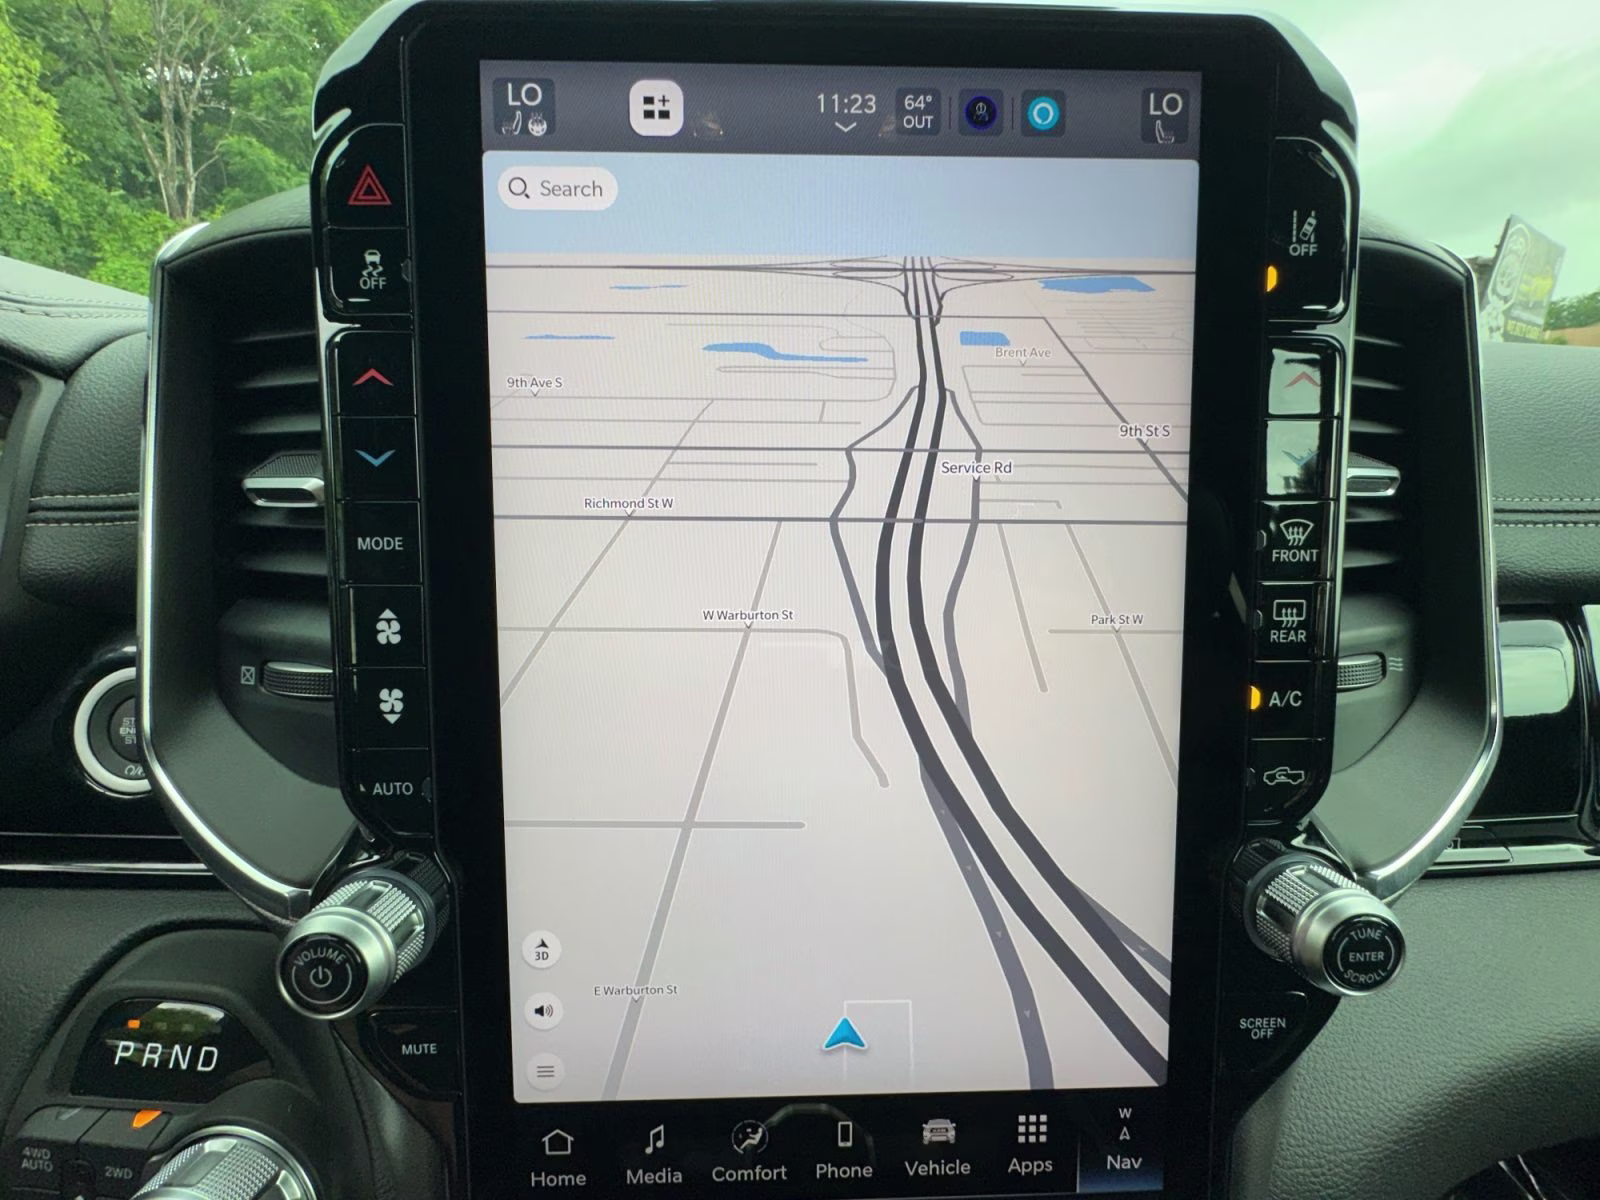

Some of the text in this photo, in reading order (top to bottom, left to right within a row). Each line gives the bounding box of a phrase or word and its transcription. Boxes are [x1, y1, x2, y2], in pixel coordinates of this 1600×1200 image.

[508, 83, 542, 107] LO
[817, 94, 877, 114] 11:23
[904, 94, 933, 111] 64°
[1150, 93, 1183, 116] LO
[903, 115, 934, 129] OUT
[540, 179, 603, 198] Search
[1289, 243, 1318, 257] OFF
[359, 276, 387, 290] OFF
[995, 347, 1051, 358] Brent Ave
[507, 377, 563, 388] 9th Ave S
[1119, 424, 1171, 438] 9th St S
[941, 461, 1013, 474] Service Rd
[584, 497, 674, 509] Richmond St W
[357, 536, 404, 550] MODE
[1272, 548, 1319, 562] FRONT
[703, 609, 794, 621] W Warburton St
[1091, 613, 1144, 625] Park St W
[1270, 630, 1307, 643] REAR
[1269, 690, 1302, 707] A/C
[373, 782, 413, 796] AUTO
[1350, 927, 1383, 941] TUNE
[294, 948, 347, 967] VOLUME
[534, 950, 549, 961] 3D
[1349, 951, 1385, 963] ENTER
[1343, 968, 1387, 985] SCROLL
[594, 984, 678, 997] E Warburton St
[1239, 1017, 1287, 1030] SCREEN
[1250, 1027, 1275, 1040] OFF
[402, 1043, 438, 1056] MUTE
[1118, 1107, 1132, 1119] W
[22, 1146, 51, 1160] 4WD
[21, 1158, 54, 1173] AUTO
[904, 1158, 971, 1177] Vehicle
[1007, 1157, 1053, 1177] Apps
[1106, 1154, 1143, 1171] Nav
[104, 1165, 133, 1180] 2WD
[626, 1168, 683, 1185] Media
[711, 1164, 788, 1183] Comfort
[815, 1162, 873, 1180] Phone
[530, 1171, 587, 1188] Home
